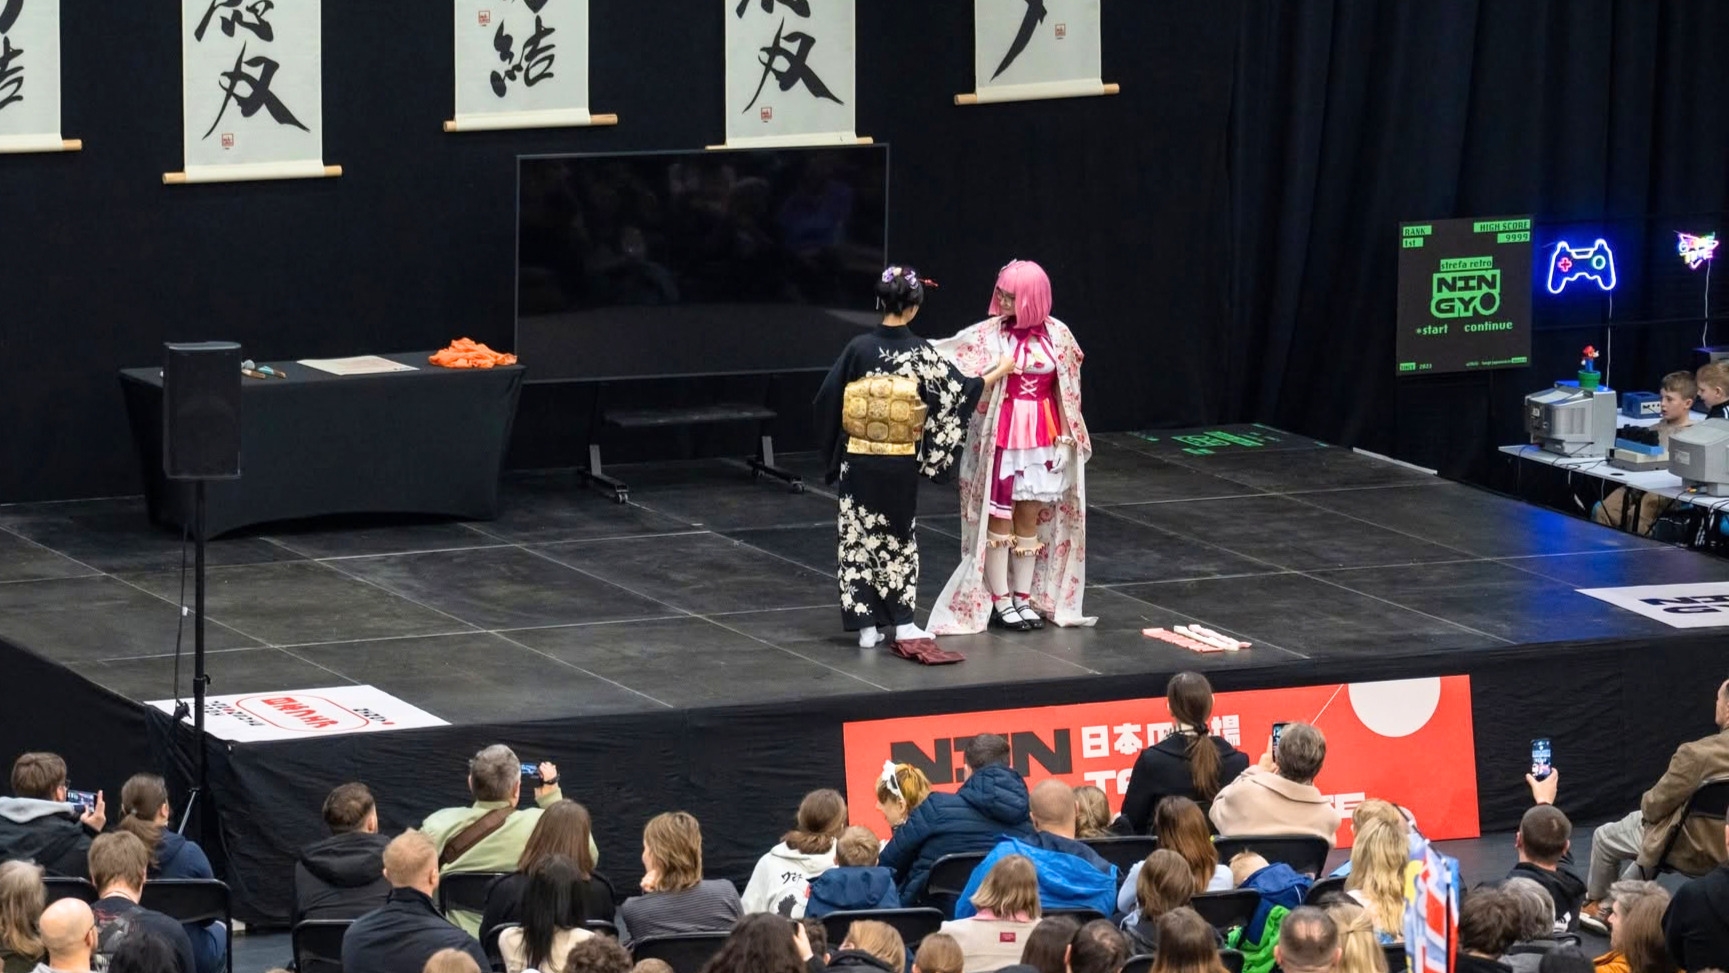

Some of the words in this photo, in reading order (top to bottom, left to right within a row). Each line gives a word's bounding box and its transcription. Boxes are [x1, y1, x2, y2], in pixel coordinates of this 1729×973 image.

[1404, 227, 1426, 236] RANK
[1479, 222, 1500, 232] HIGH
[1502, 220, 1528, 230] SCORE
[1505, 232, 1528, 240] 9999
[1441, 260, 1467, 270] strefa
[1469, 258, 1492, 268] retro
[1436, 274, 1497, 293] NIN
[1435, 292, 1497, 314] GYO
[1464, 321, 1513, 333] continue
